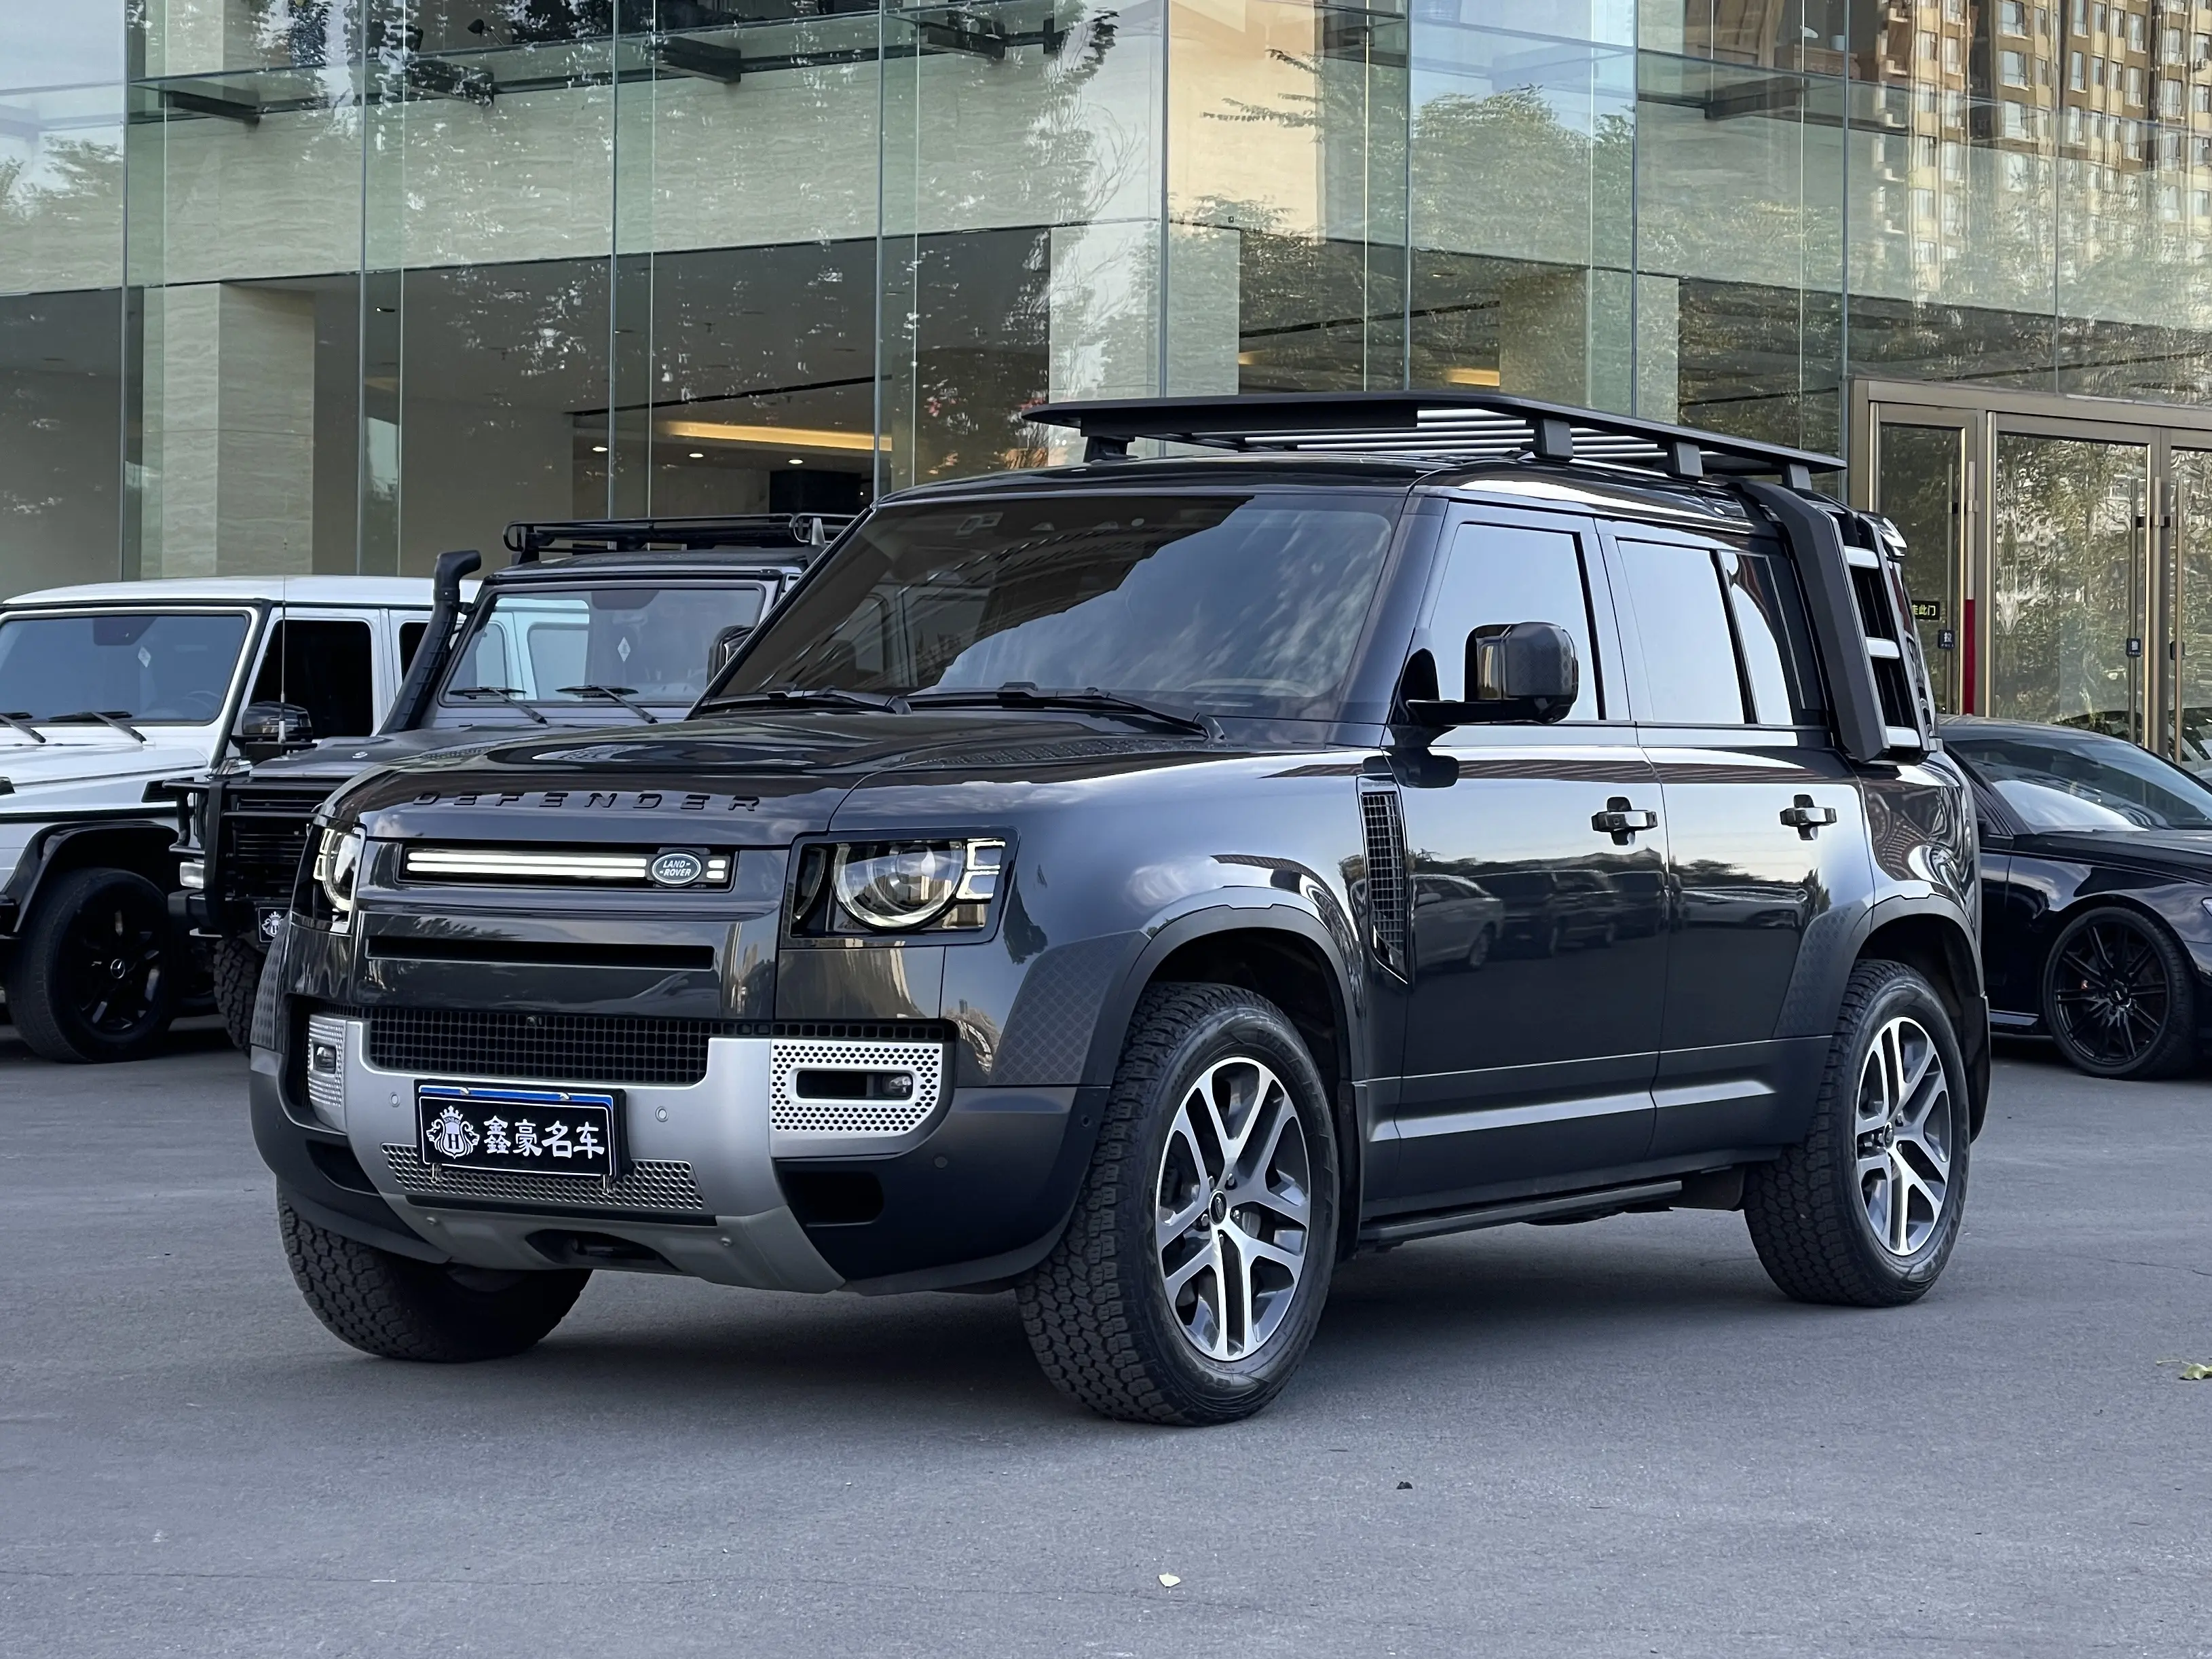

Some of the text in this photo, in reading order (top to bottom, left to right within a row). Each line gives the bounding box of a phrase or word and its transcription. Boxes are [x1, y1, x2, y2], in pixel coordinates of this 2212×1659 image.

[413, 791, 760, 811] DEFENDER
[483, 1115, 605, 1159] 鑫豪名车
